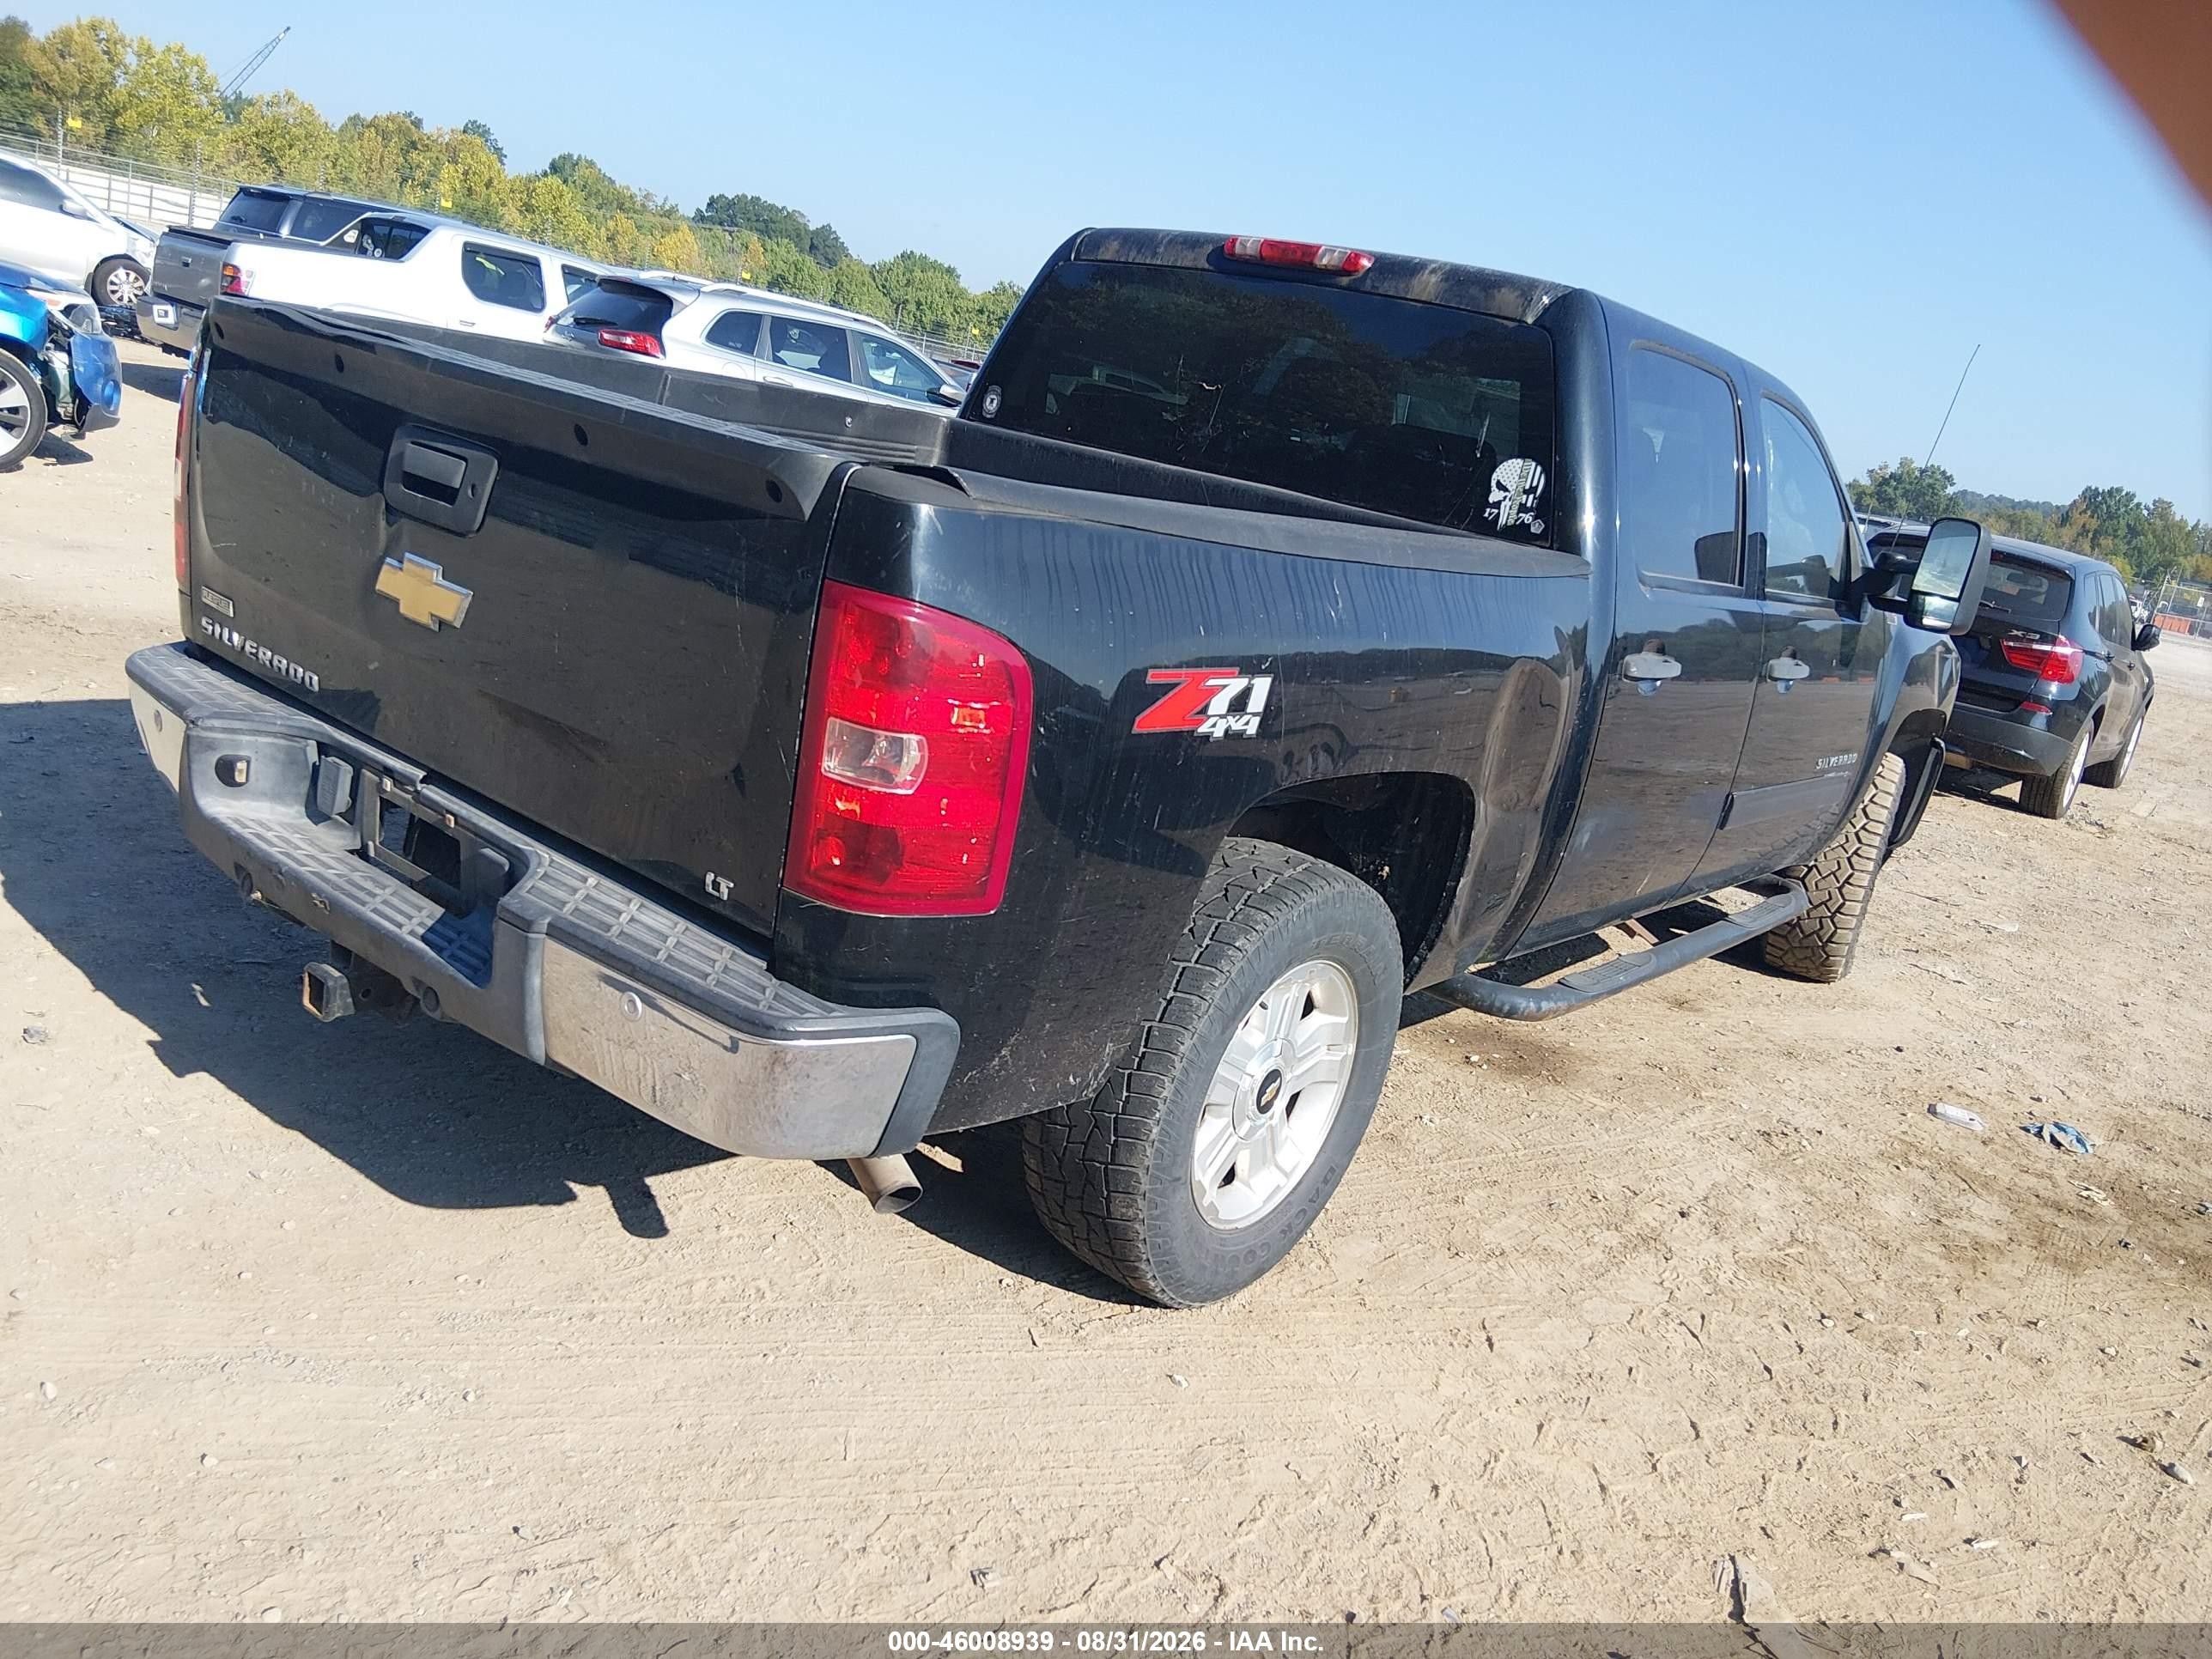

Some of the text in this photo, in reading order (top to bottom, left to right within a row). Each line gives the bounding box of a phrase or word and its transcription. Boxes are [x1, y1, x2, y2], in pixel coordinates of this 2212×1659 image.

[2008, 629, 2040, 640] X3
[201, 616, 320, 693] SILVERADO
[1131, 666, 1274, 733] Z71
[1815, 753, 1857, 770] SILVERADO
[705, 872, 734, 901] LT
